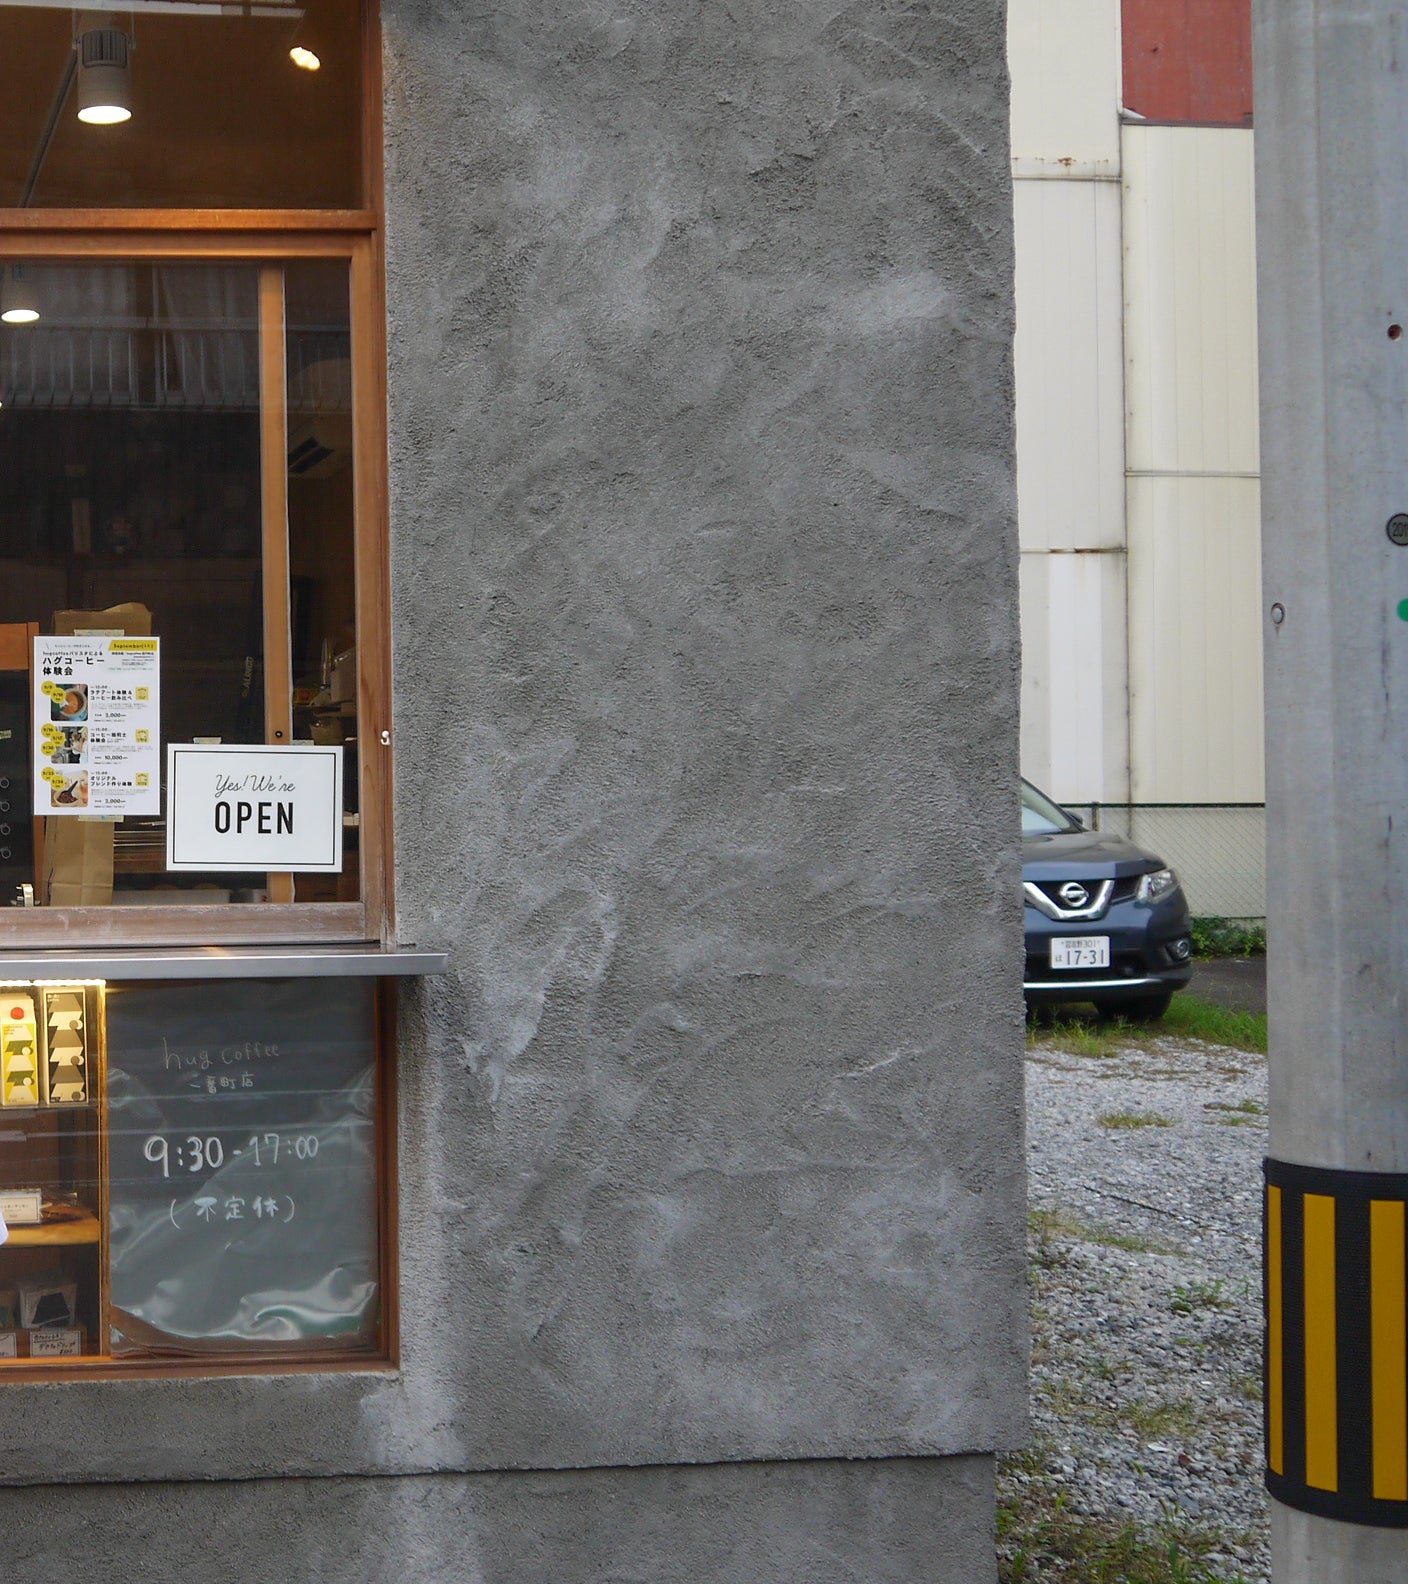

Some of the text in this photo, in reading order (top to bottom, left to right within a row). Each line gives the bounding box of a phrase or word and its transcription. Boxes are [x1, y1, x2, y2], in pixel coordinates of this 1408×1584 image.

[1392, 522, 1408, 537] 201
[42, 656, 105, 666] ハグコーヒー
[42, 666, 73, 676] 体験会
[247, 774, 296, 792] We're
[214, 801, 294, 834] OPEN
[1066, 949, 1104, 966] 17-31
[163, 1036, 213, 1071] hug
